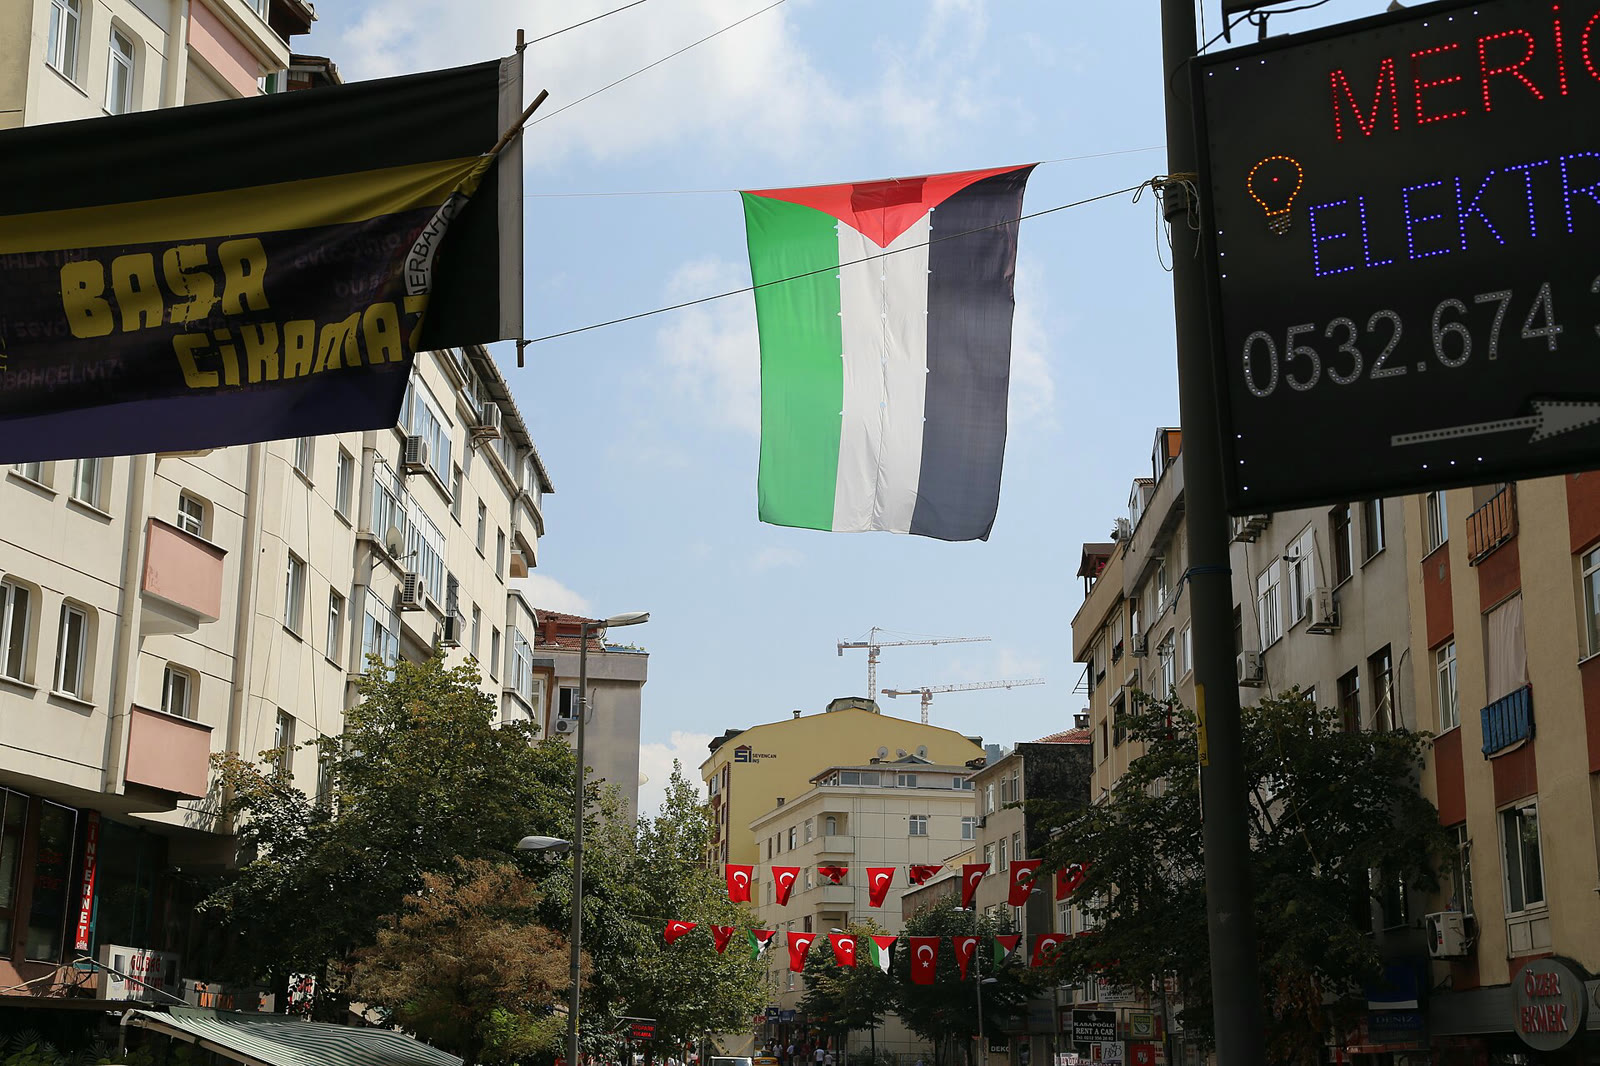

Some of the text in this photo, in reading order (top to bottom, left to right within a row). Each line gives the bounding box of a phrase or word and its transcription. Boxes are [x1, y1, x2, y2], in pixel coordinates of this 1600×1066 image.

[1242, 281, 1563, 398] 0532.674
[1525, 968, 1561, 998] ÖZER
[1521, 1004, 1568, 1032] EKMEK
